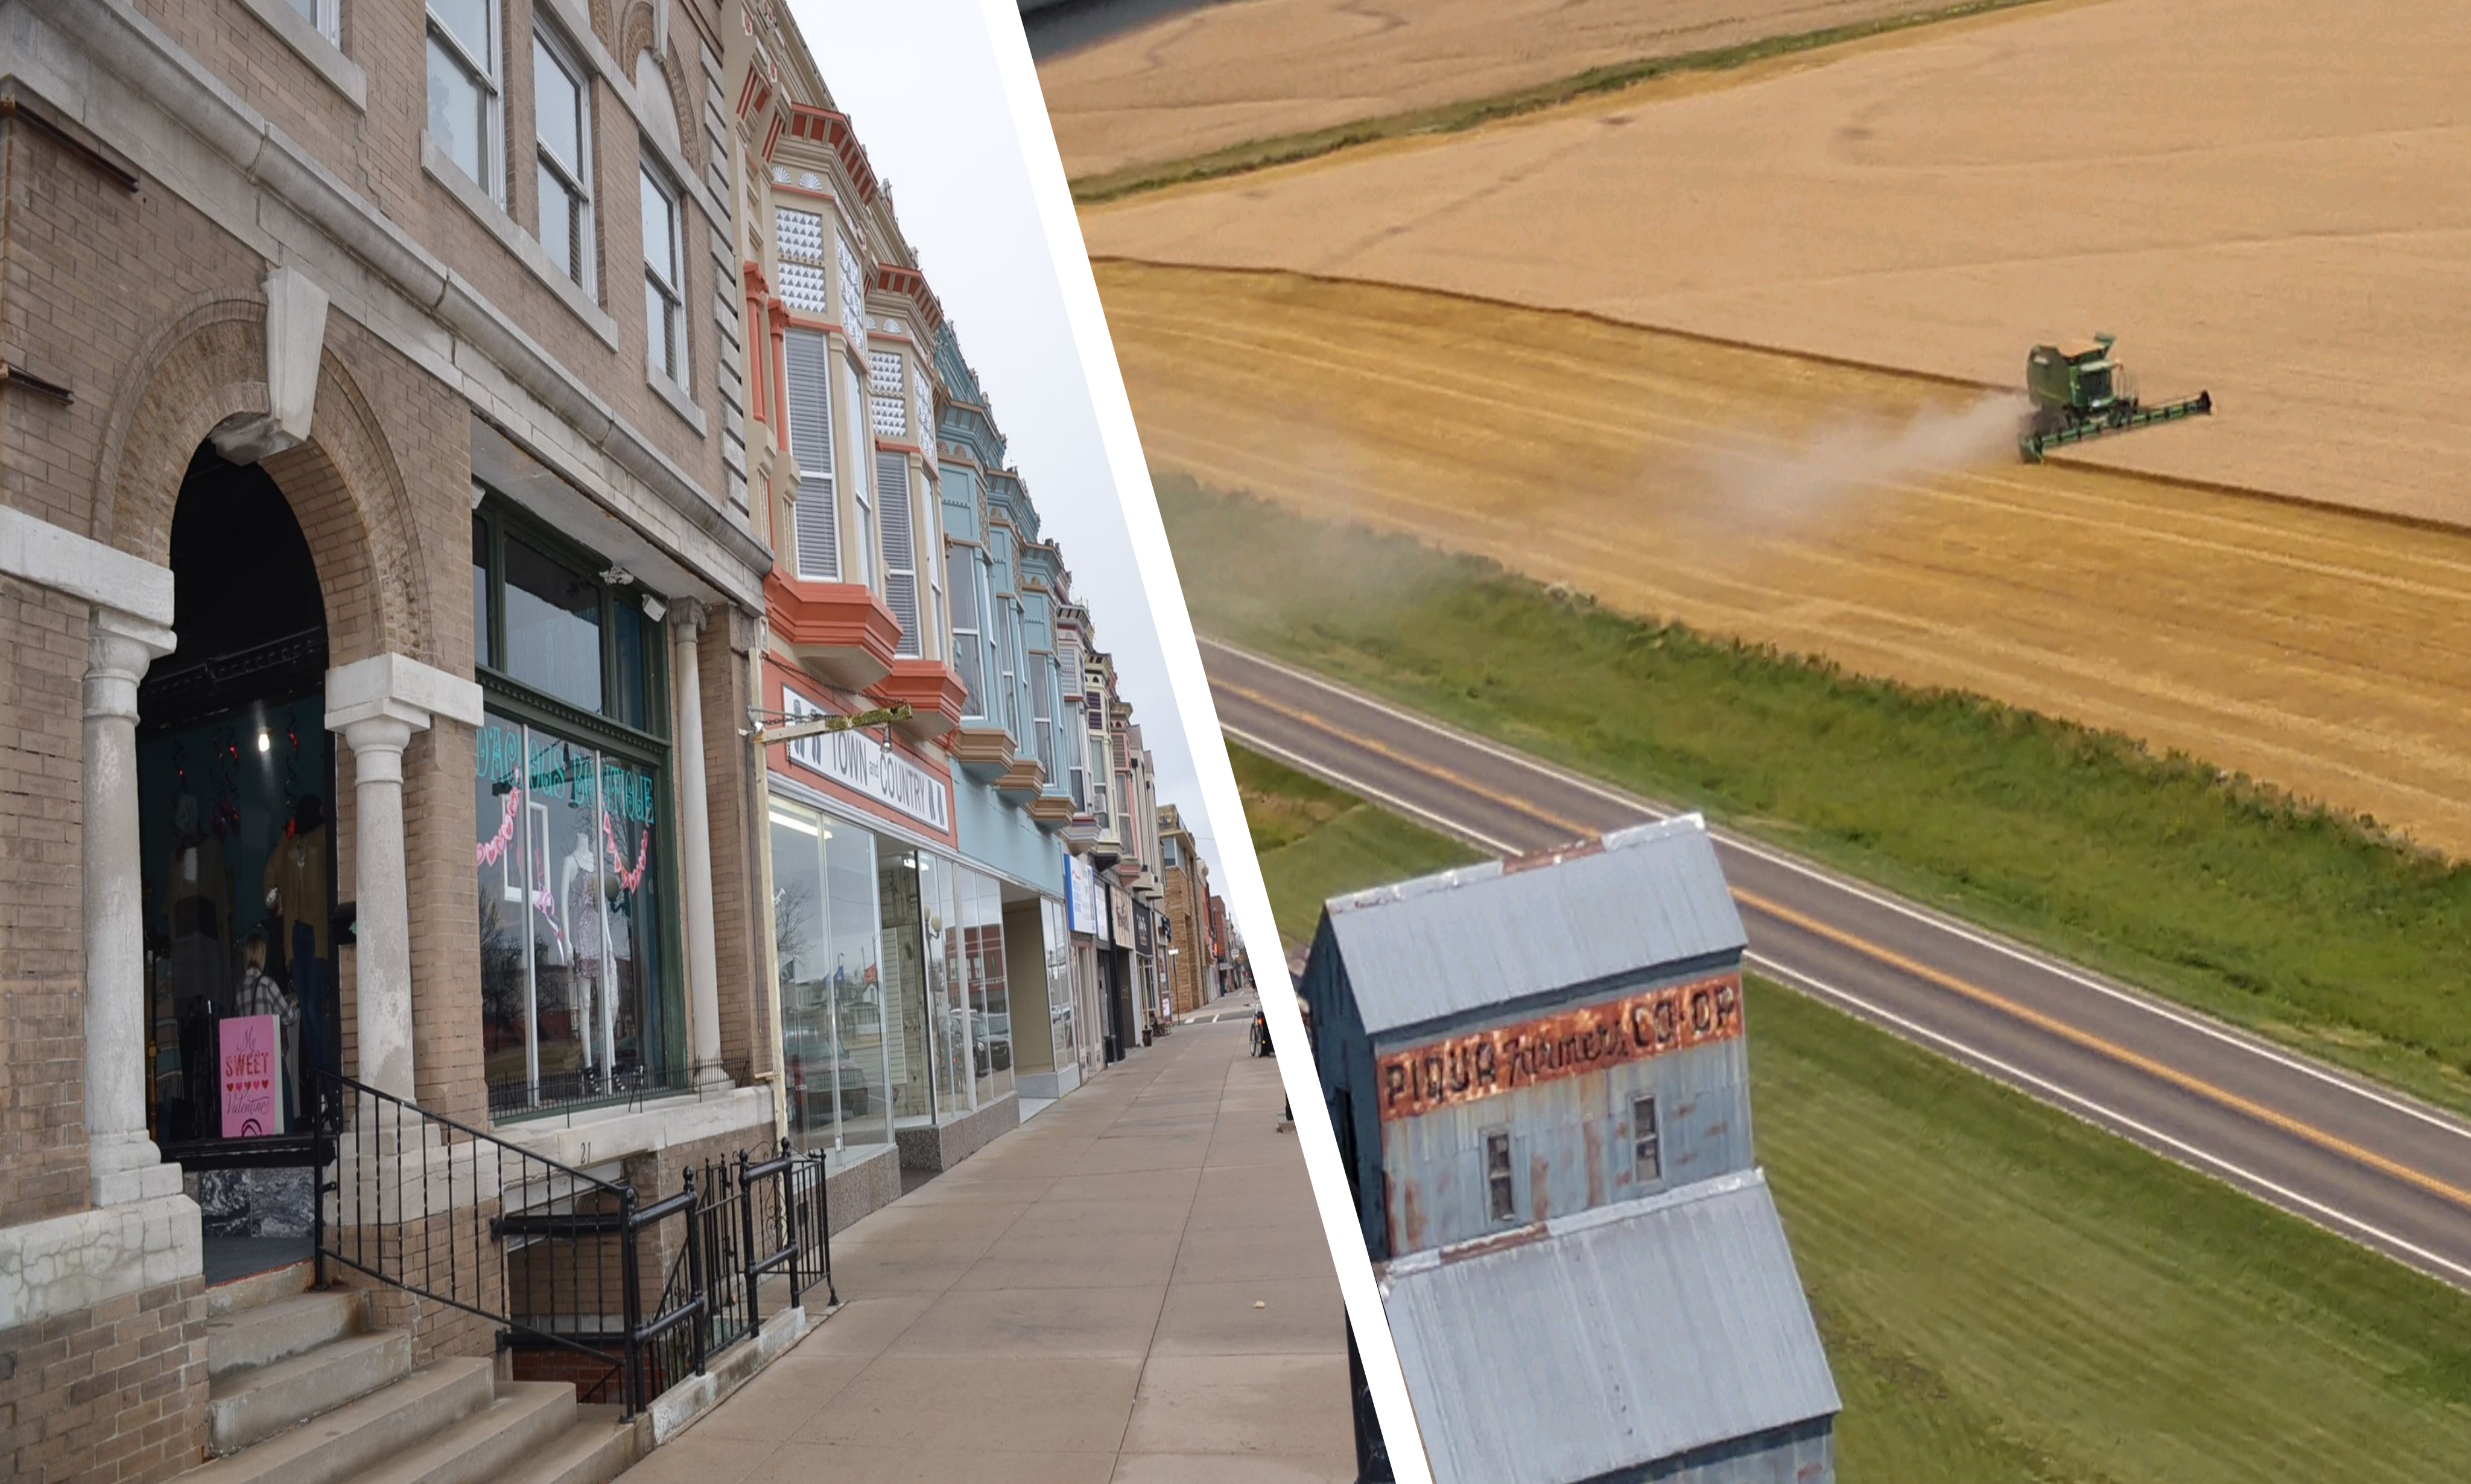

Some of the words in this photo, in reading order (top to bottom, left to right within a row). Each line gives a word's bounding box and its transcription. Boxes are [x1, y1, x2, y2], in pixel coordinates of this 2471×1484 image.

[833, 731, 868, 787] TOWN
[869, 760, 879, 778] and
[880, 753, 925, 814] COUNTRY
[236, 1026, 256, 1053] My
[226, 1053, 269, 1077] SWEET
[1386, 1042, 1495, 1106] PIQUA
[226, 1091, 270, 1115] Valentine
